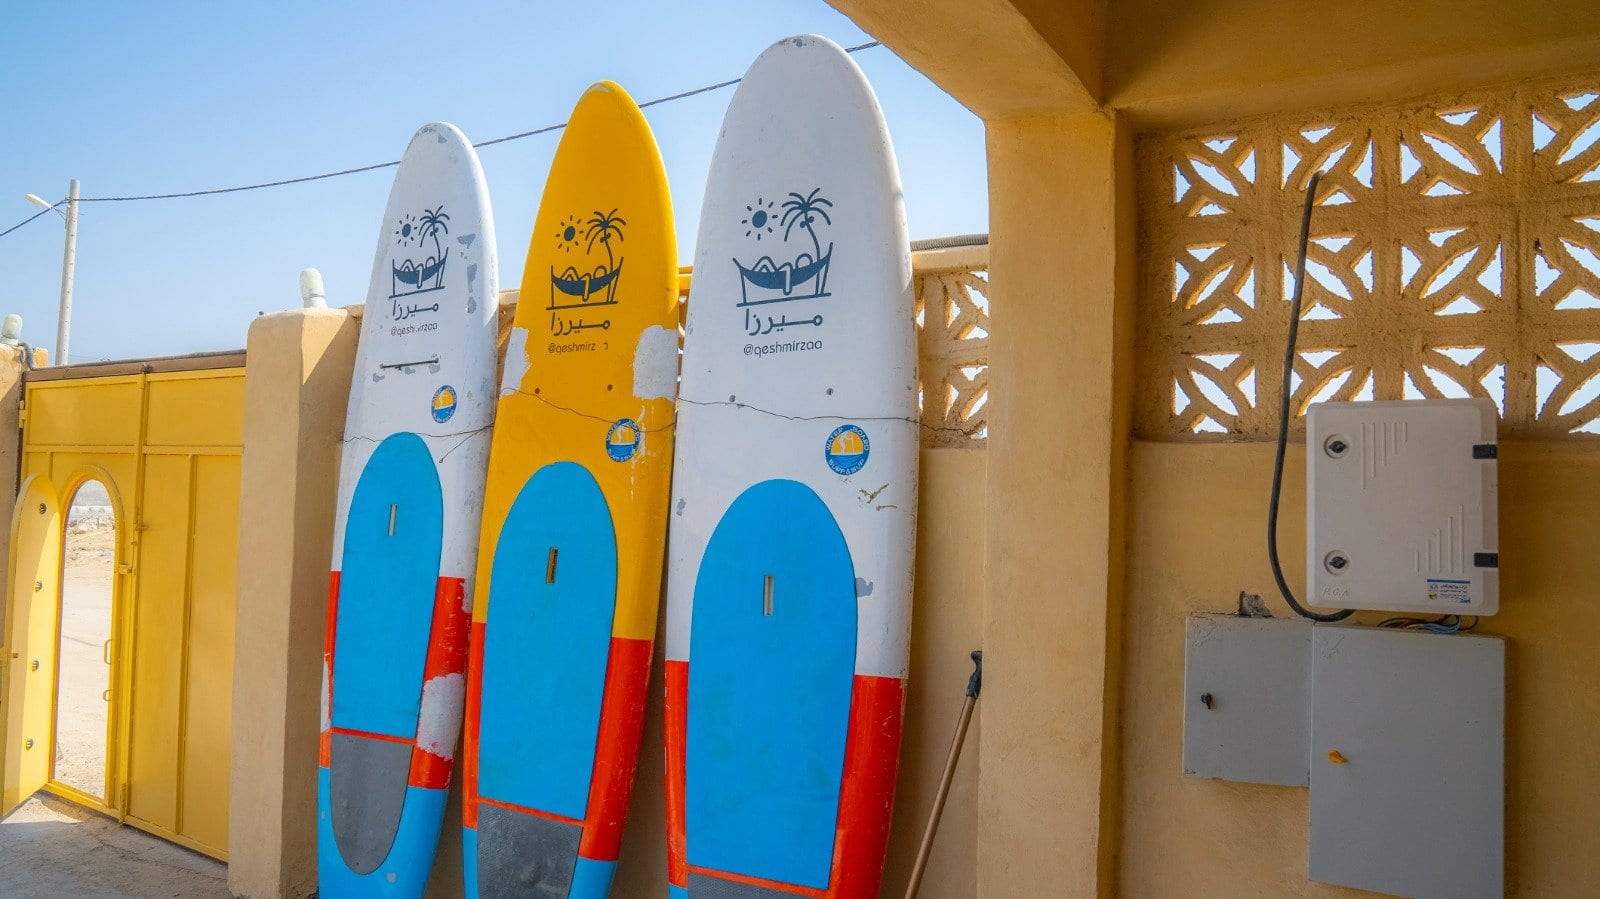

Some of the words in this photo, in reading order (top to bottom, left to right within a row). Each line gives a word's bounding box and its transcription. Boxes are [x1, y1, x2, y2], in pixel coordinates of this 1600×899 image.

[745, 308, 823, 336] میرزا
[548, 342, 609, 355] @qeshmirz
[743, 340, 823, 358] @qeshmirzaa
[825, 427, 844, 450] WATER
[851, 426, 869, 451] BOARD
